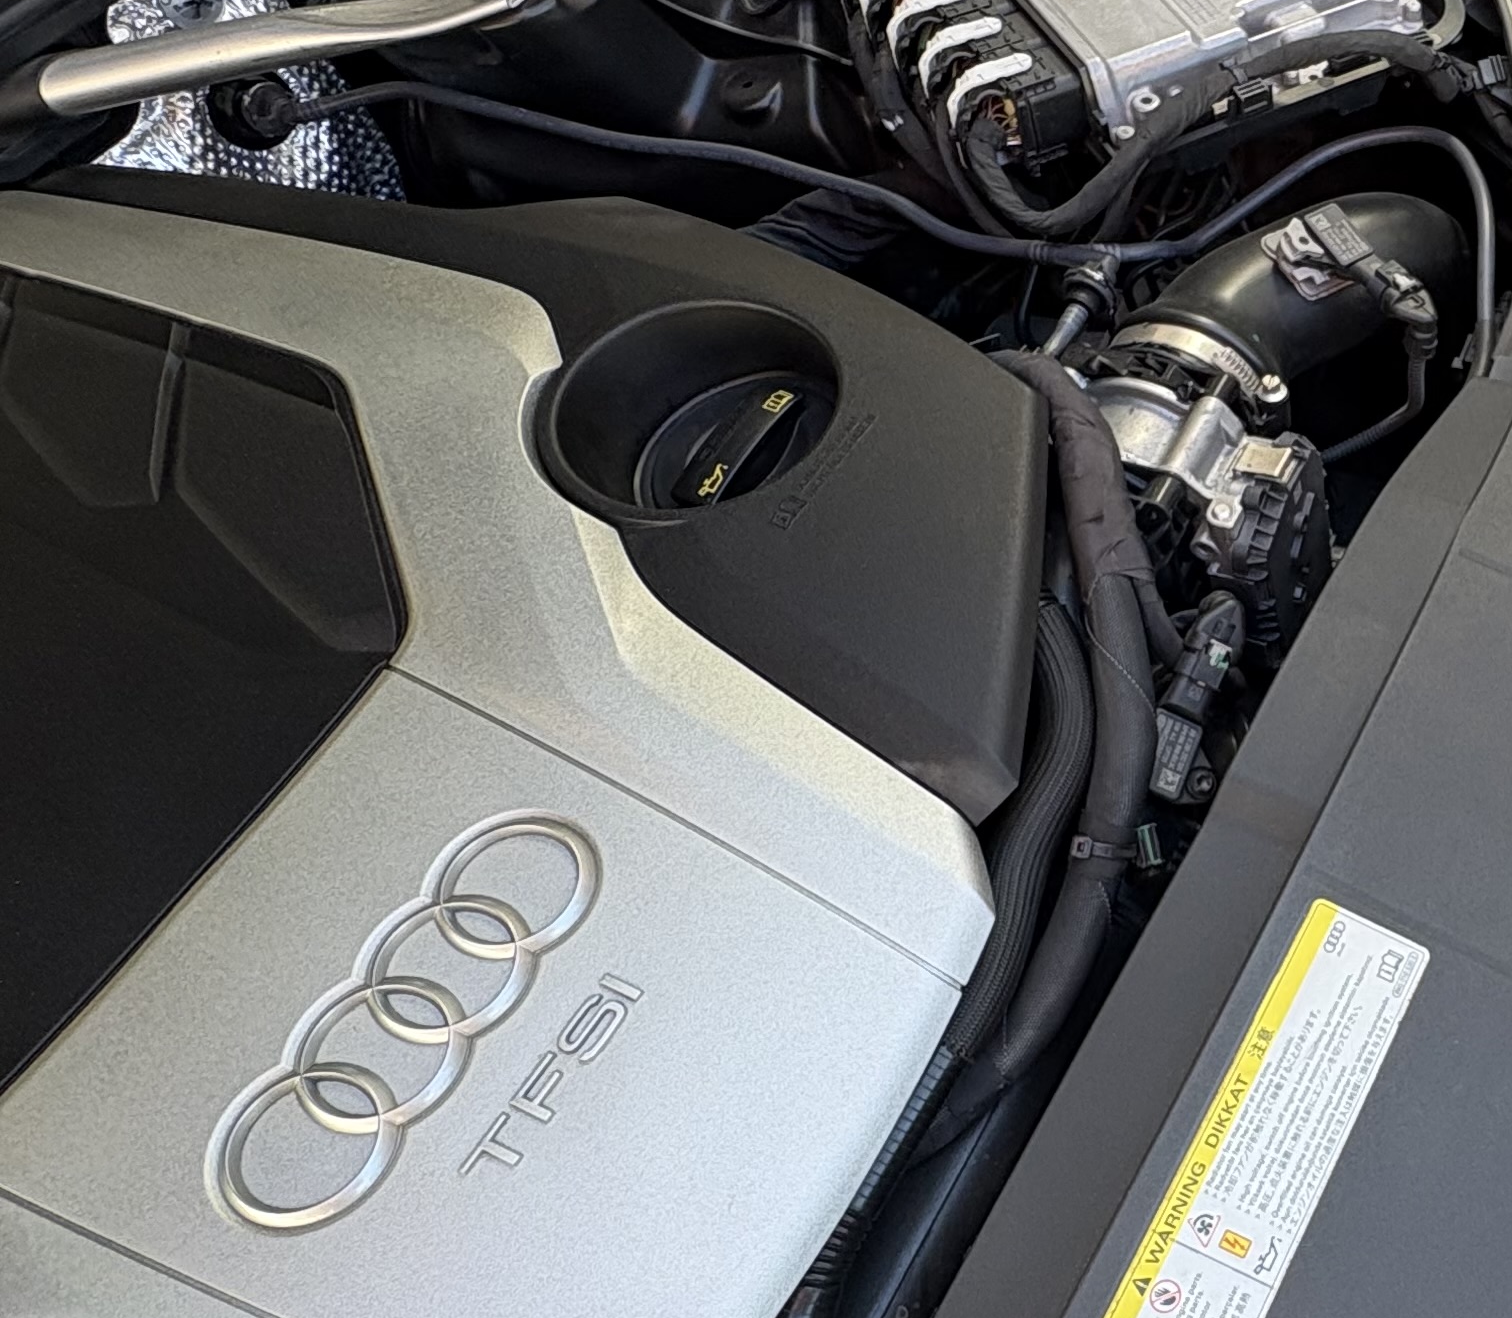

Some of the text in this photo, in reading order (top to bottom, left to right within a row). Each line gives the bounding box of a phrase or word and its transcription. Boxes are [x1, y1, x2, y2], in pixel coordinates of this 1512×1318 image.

[459, 971, 646, 1177] TFSI
[1246, 1023, 1275, 1061] 注意
[1143, 1071, 1251, 1268] WARNING DIKKAT
